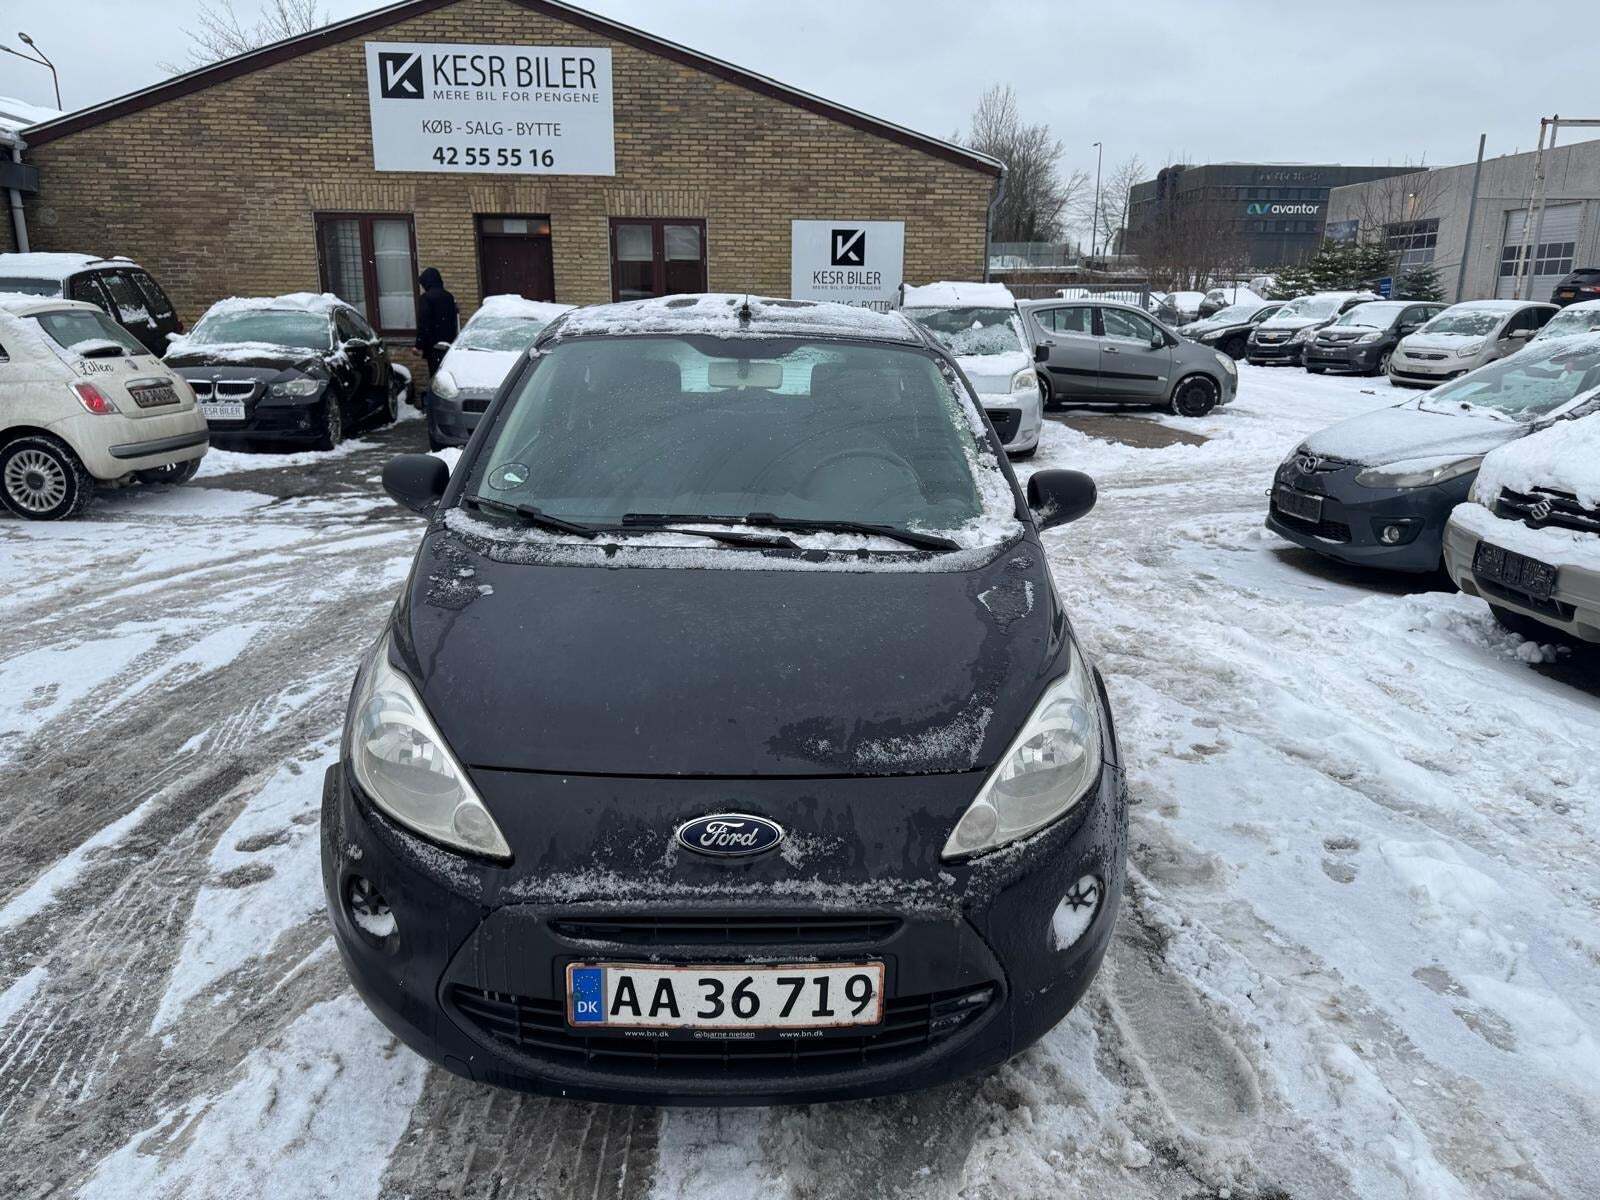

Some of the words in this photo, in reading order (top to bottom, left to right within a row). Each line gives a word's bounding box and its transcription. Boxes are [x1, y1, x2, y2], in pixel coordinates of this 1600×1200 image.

[432, 54, 506, 87] KESR
[516, 56, 597, 89] BILER
[433, 90, 470, 101] MERE
[476, 91, 497, 101] BIL
[502, 91, 530, 102] FOR
[535, 92, 600, 103] PENGENE
[422, 119, 453, 134] KØB
[465, 121, 504, 136] SALG
[516, 122, 562, 137] BYTTE
[432, 146, 459, 165] 42
[465, 147, 490, 165] 55
[497, 148, 522, 167] 55
[529, 149, 554, 168] 16
[1271, 203, 1319, 214] avantor
[813, 271, 844, 285] KESR
[847, 271, 881, 285] BILER
[700, 821, 759, 846] Ford
[609, 975, 681, 1018] AA
[696, 976, 761, 1020] 36
[776, 974, 873, 1018] 719
[577, 1001, 598, 1014] DK
[624, 1030, 670, 1038] www.bn.dk
[779, 1030, 824, 1038] www.bn.dk
